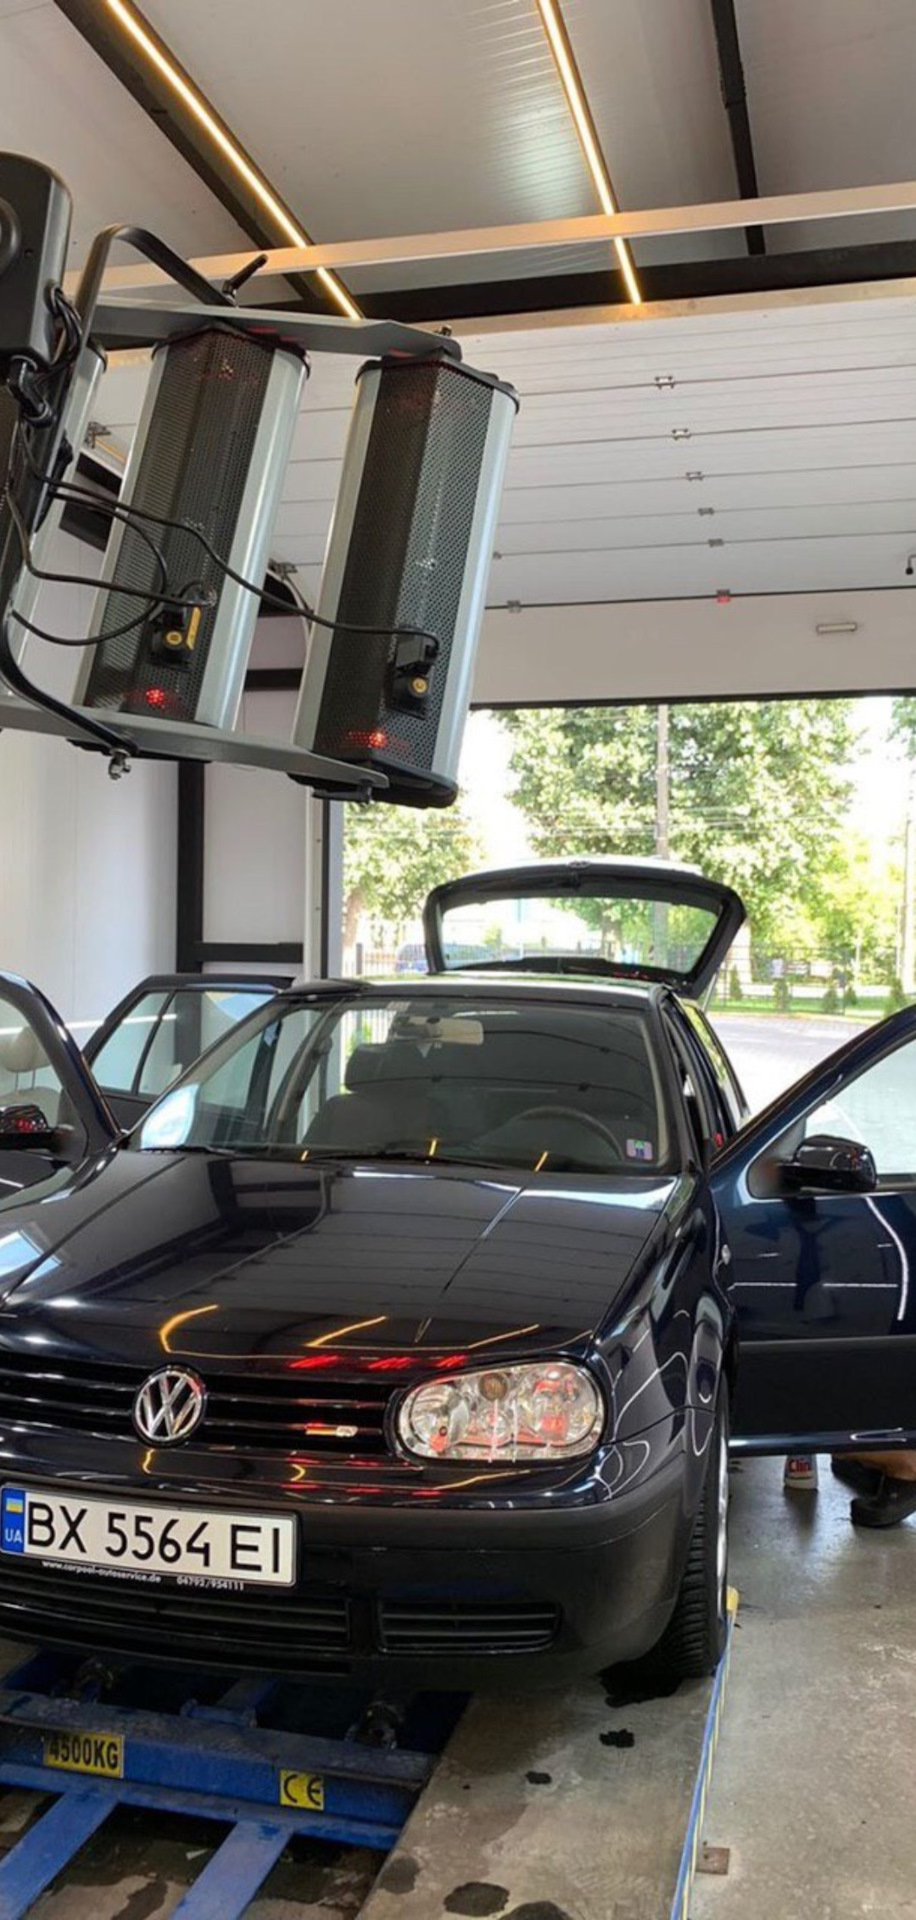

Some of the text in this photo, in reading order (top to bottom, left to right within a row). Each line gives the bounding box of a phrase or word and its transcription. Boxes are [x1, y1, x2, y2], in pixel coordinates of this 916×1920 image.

[788, 1458, 812, 1473] Clin
[4, 1528, 23, 1544] UA
[27, 1501, 280, 1574] BX 5564 EI
[48, 1735, 119, 1770] 4500KG
[283, 1773, 322, 1806] CE
